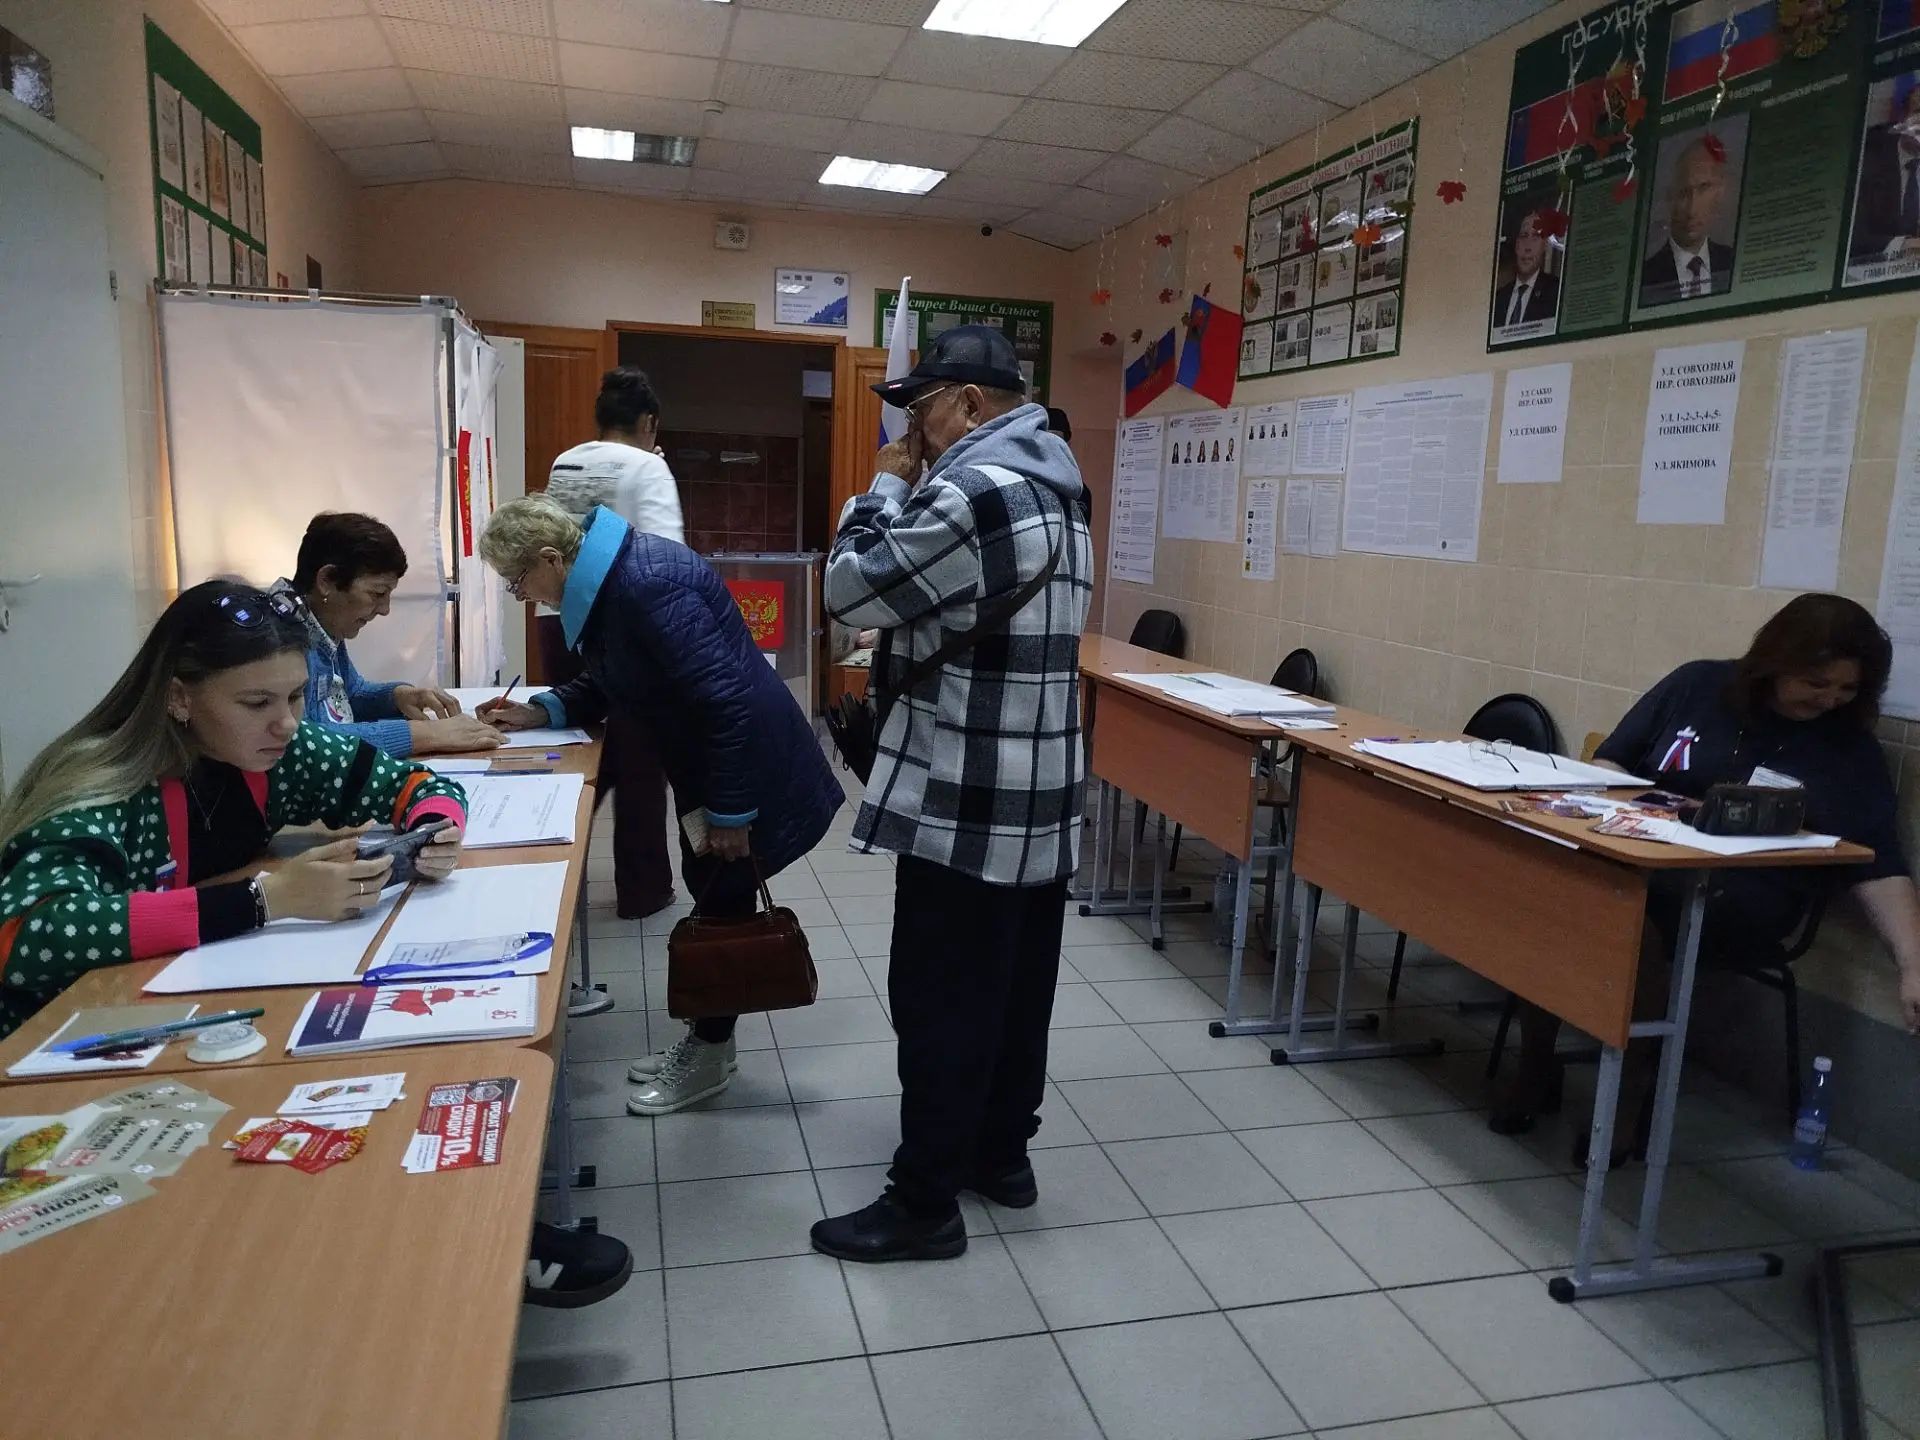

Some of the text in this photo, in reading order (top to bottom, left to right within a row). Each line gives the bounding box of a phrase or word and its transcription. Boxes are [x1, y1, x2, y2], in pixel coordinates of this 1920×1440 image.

[948, 300, 986, 313] Выше
[990, 303, 1040, 318] Сильнее
[1677, 360, 1734, 376] СОВХОЗНАЯ
[1656, 373, 1736, 390] ПЕР. СОВХОЗНЫЙ
[1521, 425, 1557, 436] СЕМАШКО
[1659, 423, 1721, 436] ТОПКИНСКИЕ
[1670, 459, 1716, 470] ЯКИМОВА
